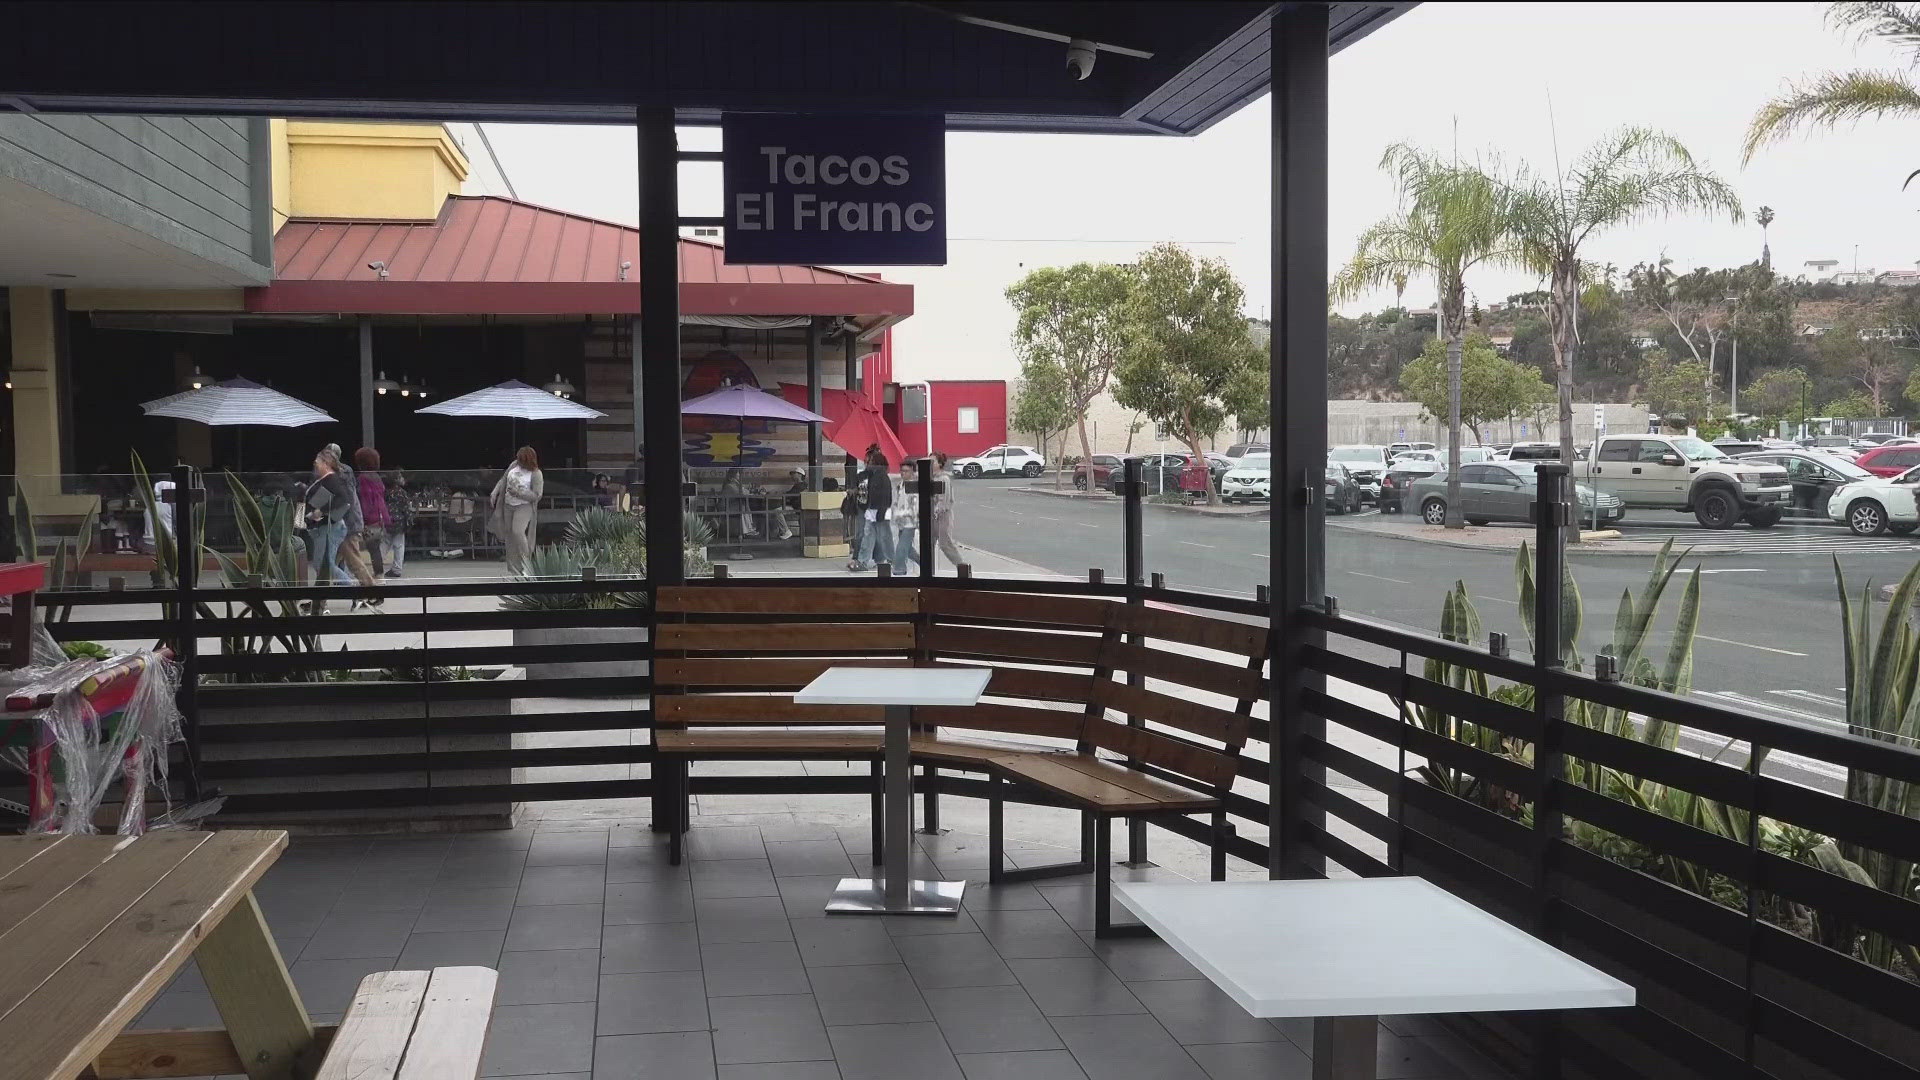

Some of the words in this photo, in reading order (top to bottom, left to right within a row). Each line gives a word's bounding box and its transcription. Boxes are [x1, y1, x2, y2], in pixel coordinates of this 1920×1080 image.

[760, 146, 910, 186] Tacos
[736, 192, 774, 231] El
[793, 193, 934, 232] Franc
